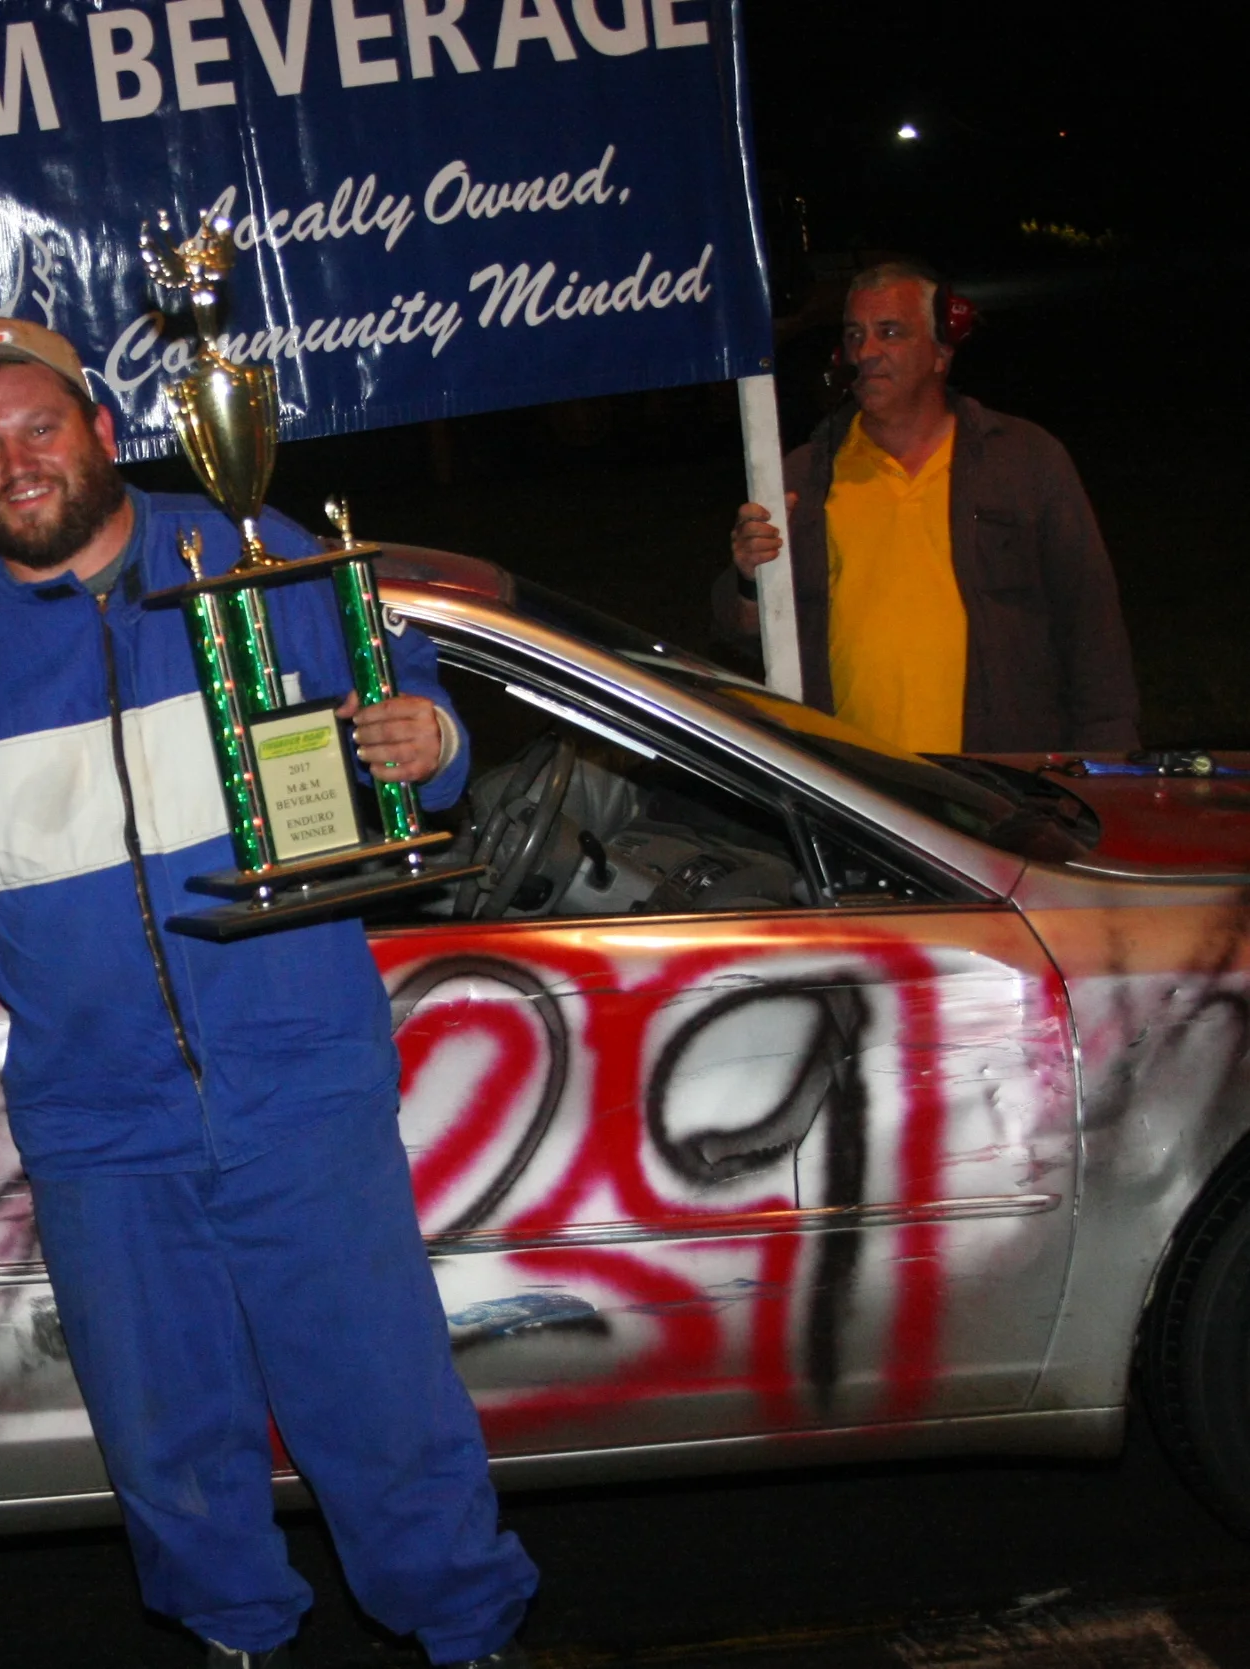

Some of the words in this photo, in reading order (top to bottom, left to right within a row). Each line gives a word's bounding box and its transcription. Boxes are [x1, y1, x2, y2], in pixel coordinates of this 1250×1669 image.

[424, 144, 630, 225] Owned,
[469, 243, 713, 328] Minded
[288, 762, 310, 776] 2017
[276, 788, 337, 811] BEVERAGE
[286, 811, 335, 829] ENDURO
[290, 824, 336, 841] WINNER
